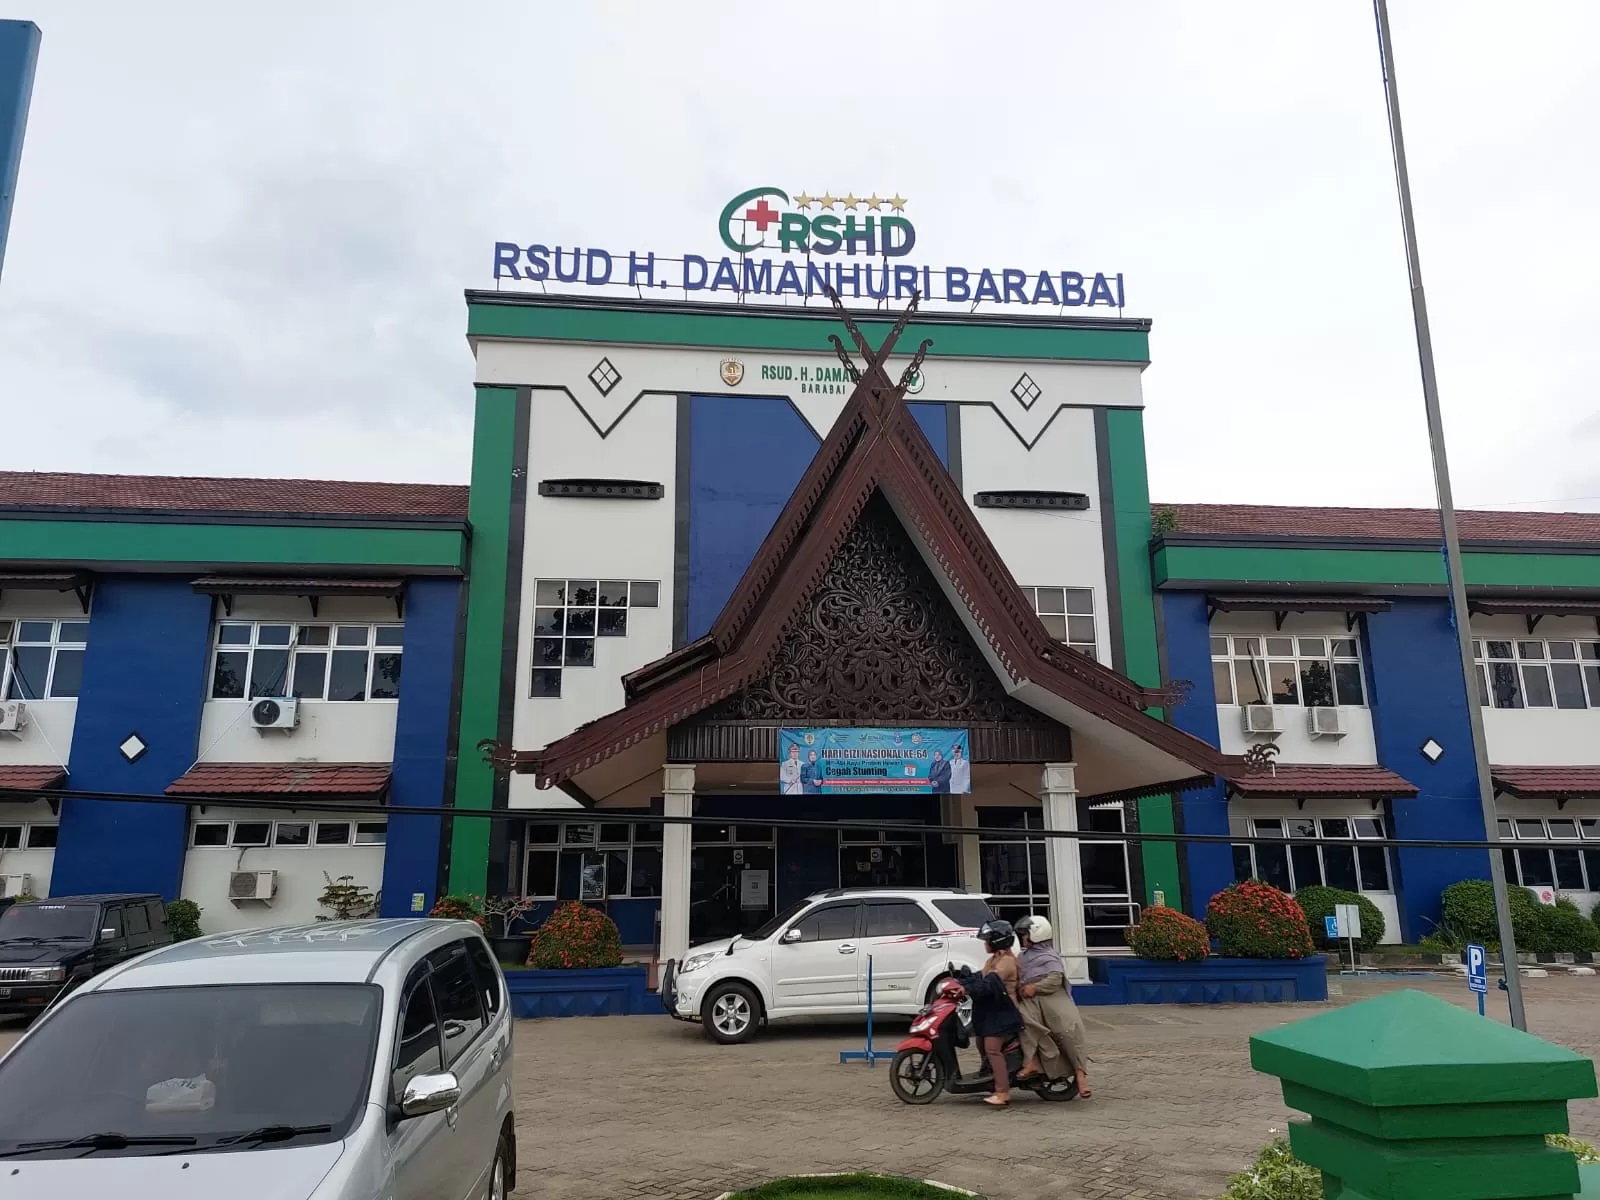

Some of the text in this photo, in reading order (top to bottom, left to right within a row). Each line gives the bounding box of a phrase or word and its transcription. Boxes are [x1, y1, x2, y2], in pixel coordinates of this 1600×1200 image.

[493, 241, 1125, 308] RSUD H. DAMANHURI BARABAI
[801, 383, 846, 395] BARABAI
[821, 748, 928, 759] HARI GIZI NASIONAL KE-64
[825, 766, 888, 777] Cegah Stunting
[1470, 948, 1482, 975] P
